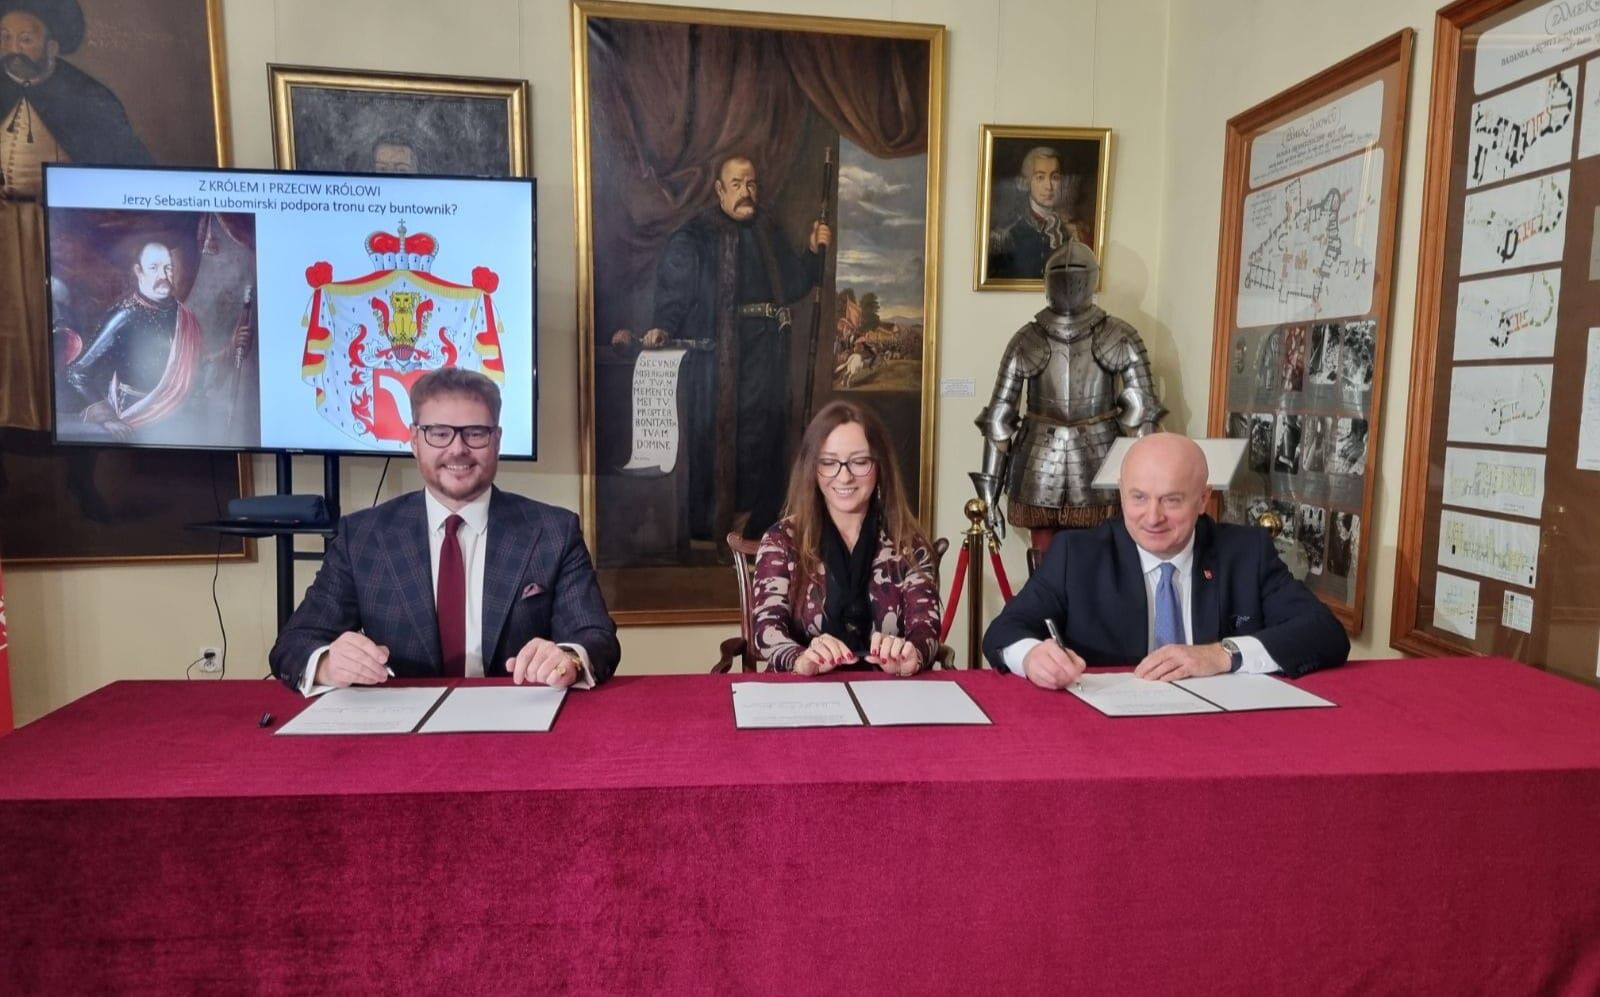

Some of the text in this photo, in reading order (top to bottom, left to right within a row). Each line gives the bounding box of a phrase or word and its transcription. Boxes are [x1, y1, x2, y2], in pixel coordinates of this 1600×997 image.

[199, 179, 206, 192] Z
[209, 178, 259, 193] KRÓLEM
[269, 181, 322, 195] PRZECIW
[325, 182, 381, 197] KRÓLOWI
[122, 193, 458, 216] Jerzy Sebastian Lubomirski podpora tronu czy buntownik?
[633, 387, 674, 397] MEMENTO
[637, 408, 672, 417] PROPTER
[636, 439, 671, 451] DOMINE
